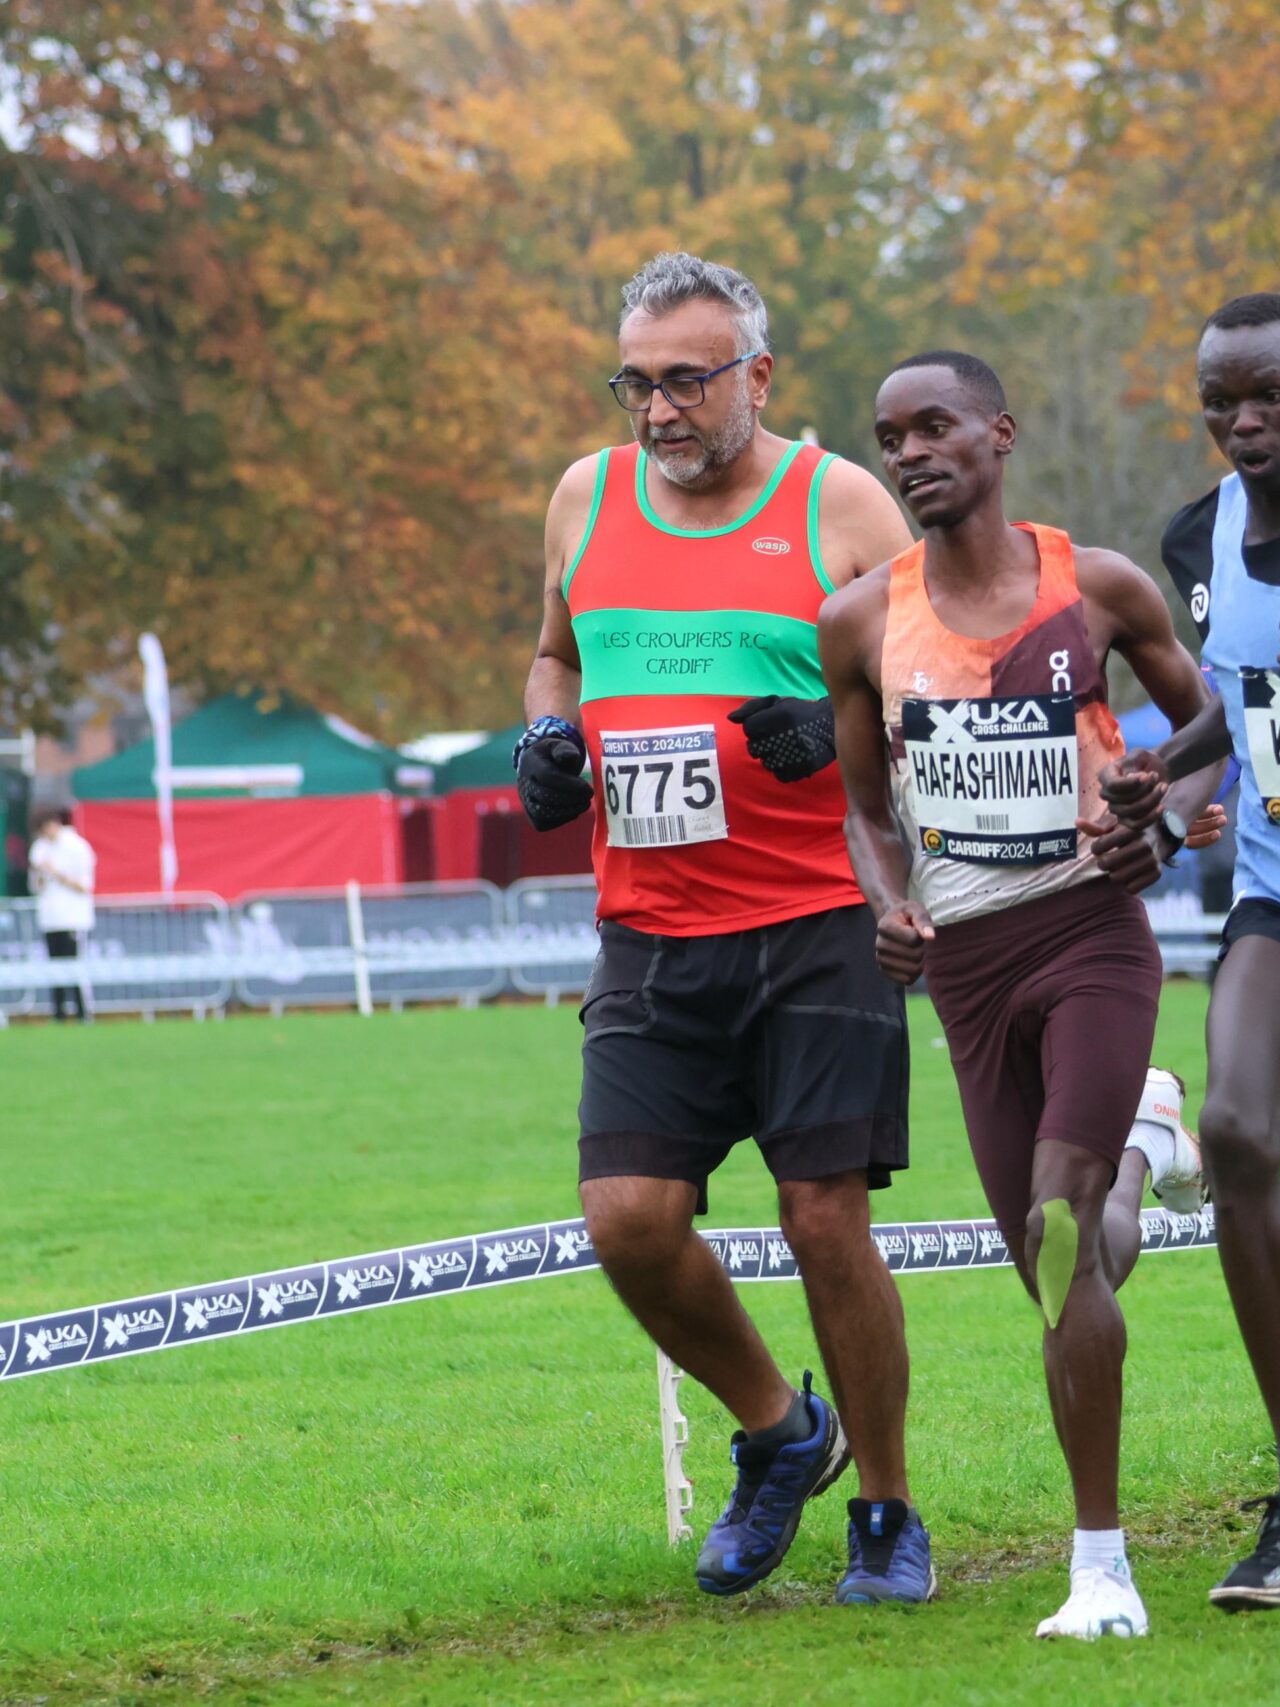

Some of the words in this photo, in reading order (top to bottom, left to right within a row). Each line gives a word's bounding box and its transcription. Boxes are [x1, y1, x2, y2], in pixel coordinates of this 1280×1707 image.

[755, 541, 787, 553] wasp
[602, 632, 631, 649] LES
[636, 631, 732, 648] CROUPIERS
[646, 658, 714, 675] CARDIFF
[971, 724, 999, 735] CROSS
[1001, 721, 1049, 734] CHALLENGE
[604, 742, 629, 753] GWENT
[632, 741, 649, 752] XC
[652, 736, 701, 751] 2024/25
[912, 747, 1073, 800] HAFASHIMANA
[605, 758, 716, 815] 6775
